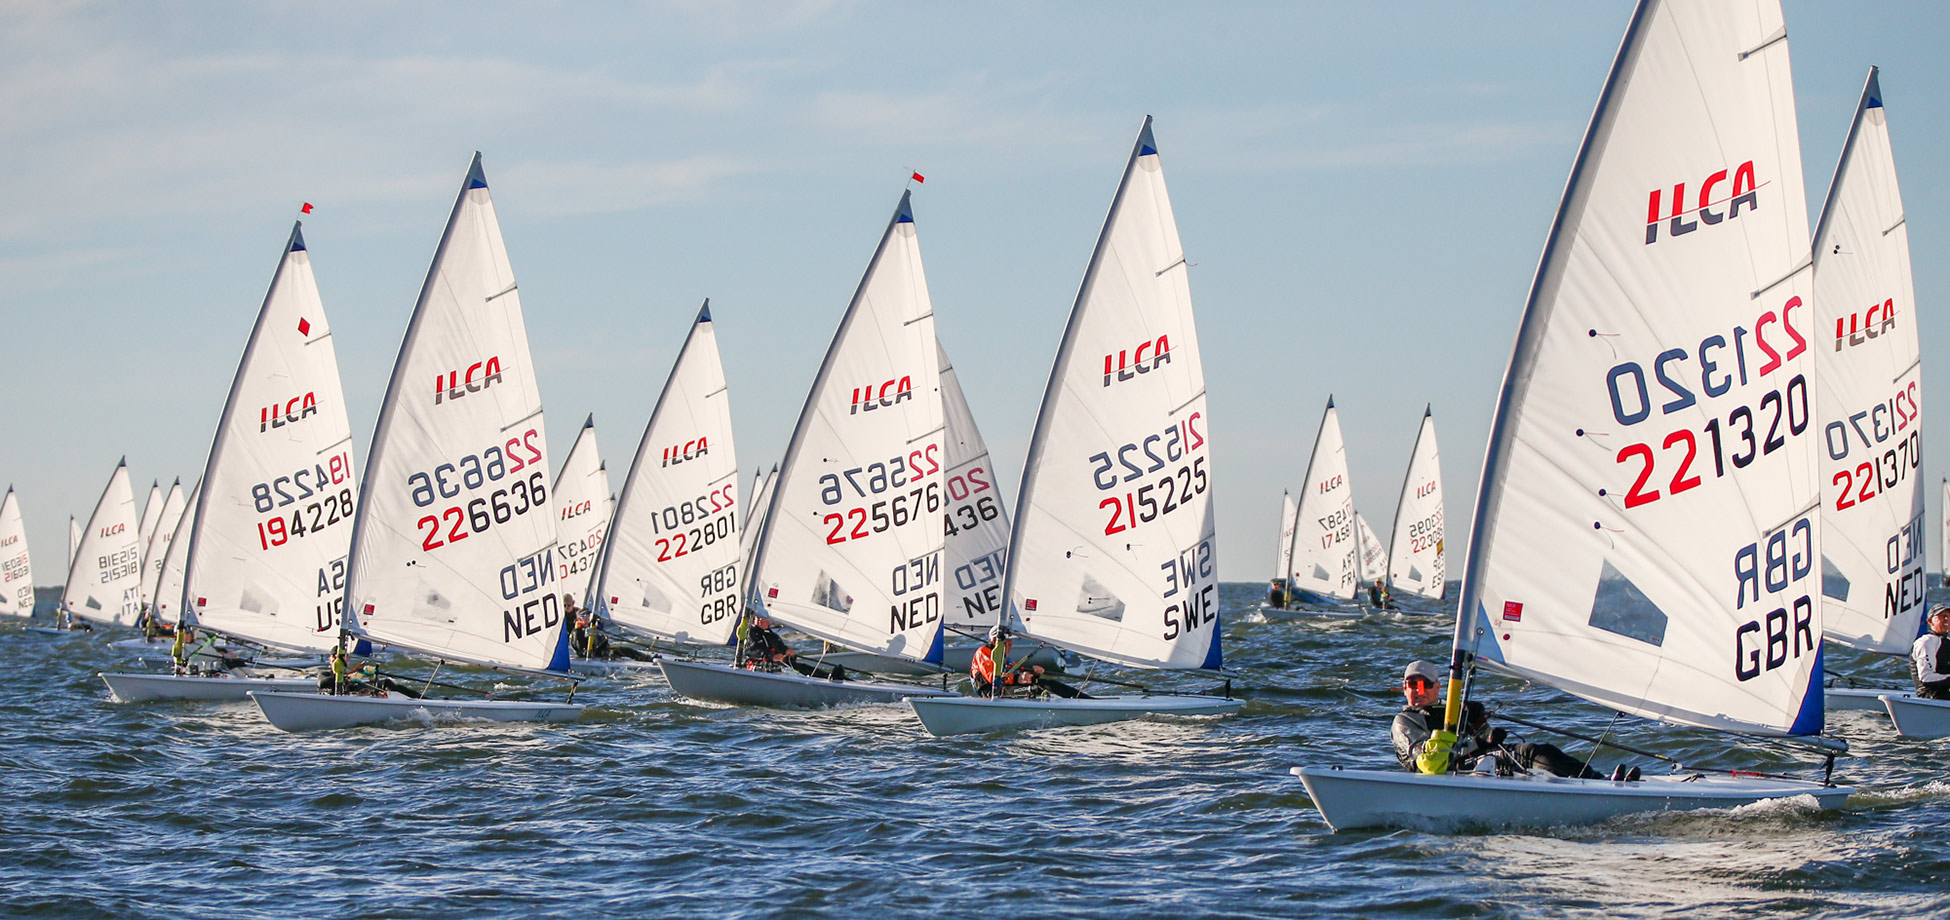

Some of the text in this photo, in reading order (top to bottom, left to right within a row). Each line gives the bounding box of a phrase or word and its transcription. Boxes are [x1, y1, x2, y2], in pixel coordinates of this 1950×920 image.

[1645, 160, 1758, 245] ILCA
[1835, 297, 1896, 352] ILCA
[435, 356, 502, 405] ILCA
[1103, 334, 1170, 388] ILCA
[260, 391, 317, 433] ILCA
[850, 375, 911, 415] ILCA
[662, 436, 708, 468] ILCA
[1616, 374, 1808, 509] 221320
[1320, 474, 1342, 495] ILCA
[1417, 480, 1436, 499] ILCA
[1832, 430, 1921, 511] 221370
[257, 488, 354, 551] 194228
[417, 471, 546, 552] 226636
[561, 499, 591, 521] ILCA
[823, 482, 939, 545] 225676
[1099, 456, 1207, 536] 215225
[1, 535, 18, 547] ILCA
[100, 522, 125, 538] ILCA
[655, 511, 735, 562] 222801
[100, 562, 138, 584] 215318
[560, 549, 599, 580] 0437
[122, 604, 139, 617] ITA
[503, 592, 559, 643] NED
[701, 594, 737, 625] GBR
[890, 592, 939, 634] NED
[963, 584, 1000, 618] NE
[1163, 584, 1216, 642] SWE
[1884, 567, 1923, 620] NED
[1734, 594, 1814, 683] GBR
